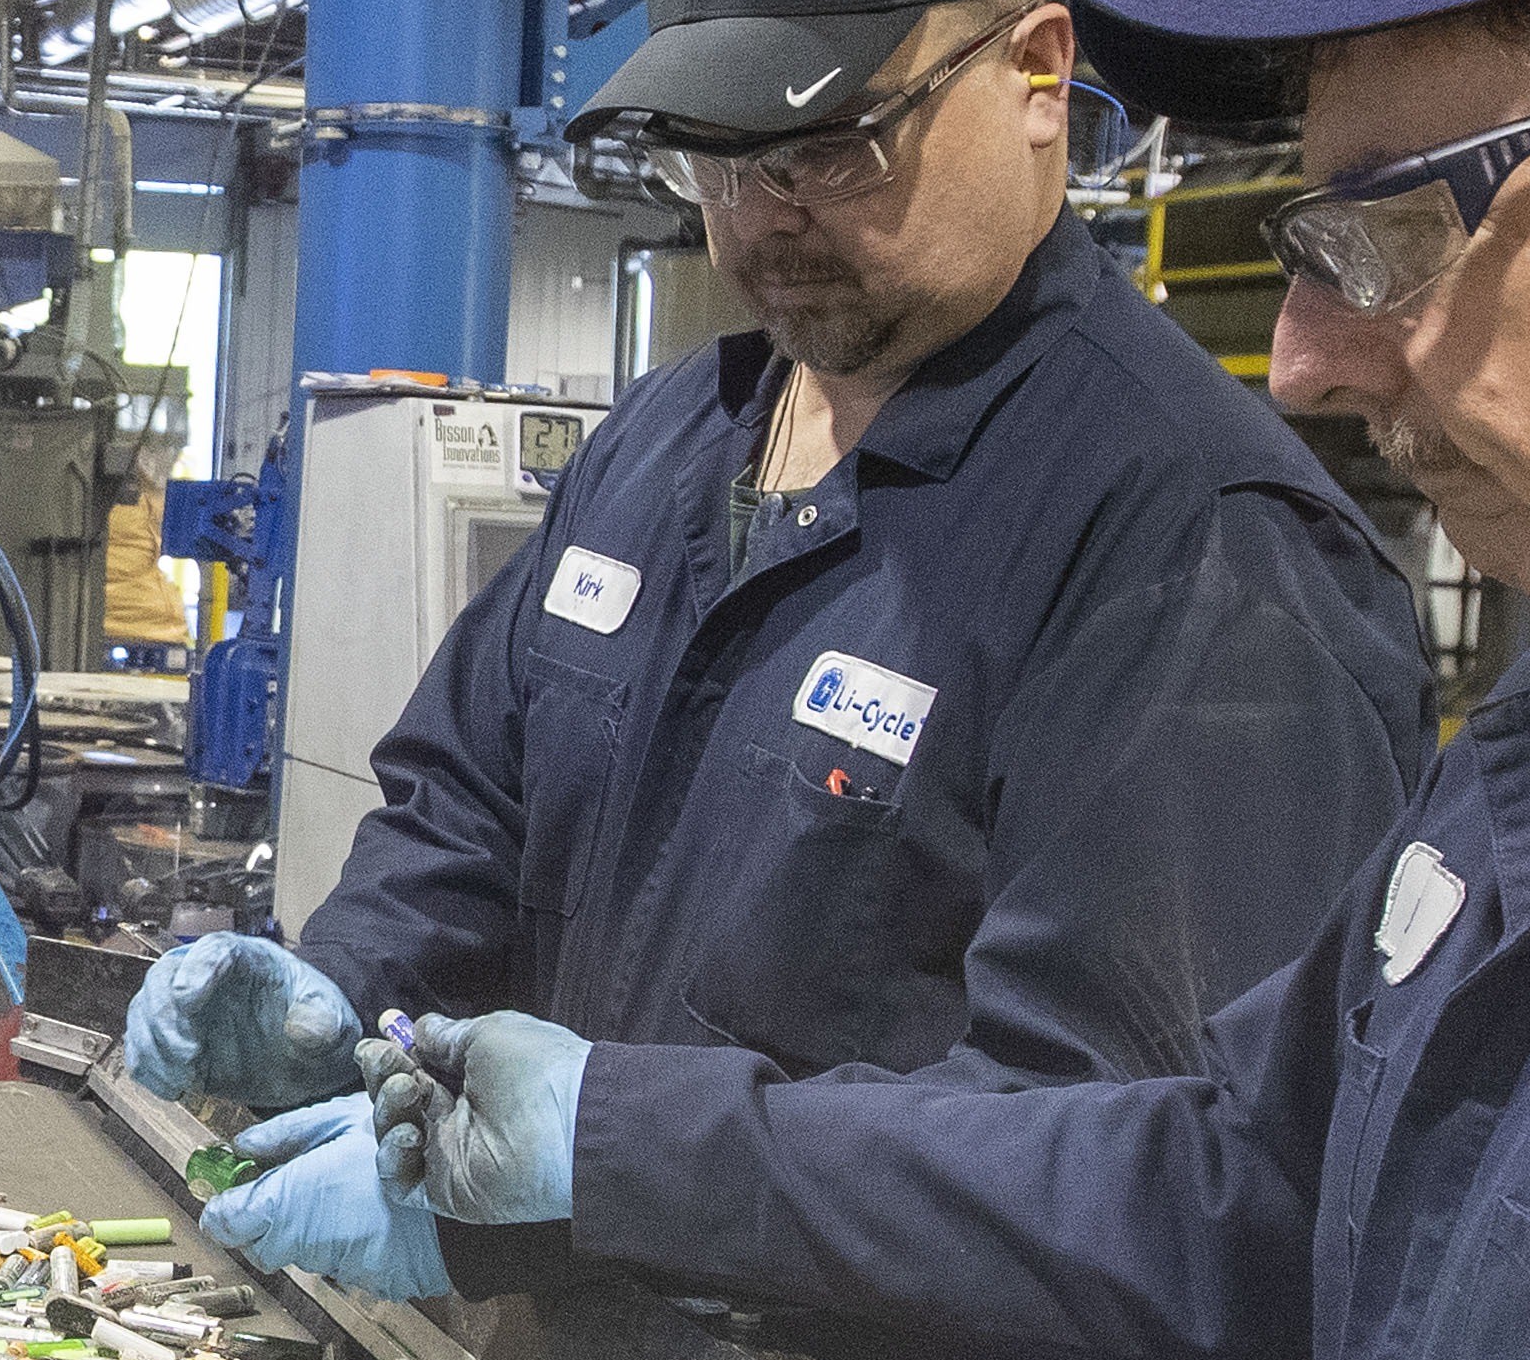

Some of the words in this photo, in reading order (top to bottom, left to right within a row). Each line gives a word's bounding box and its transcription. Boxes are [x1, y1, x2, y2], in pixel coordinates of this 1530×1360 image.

[435, 417, 476, 444] Bisson
[442, 444, 502, 464] Innovations
[575, 571, 604, 602] Kirk
[835, 694, 918, 742] Li-Cycle
